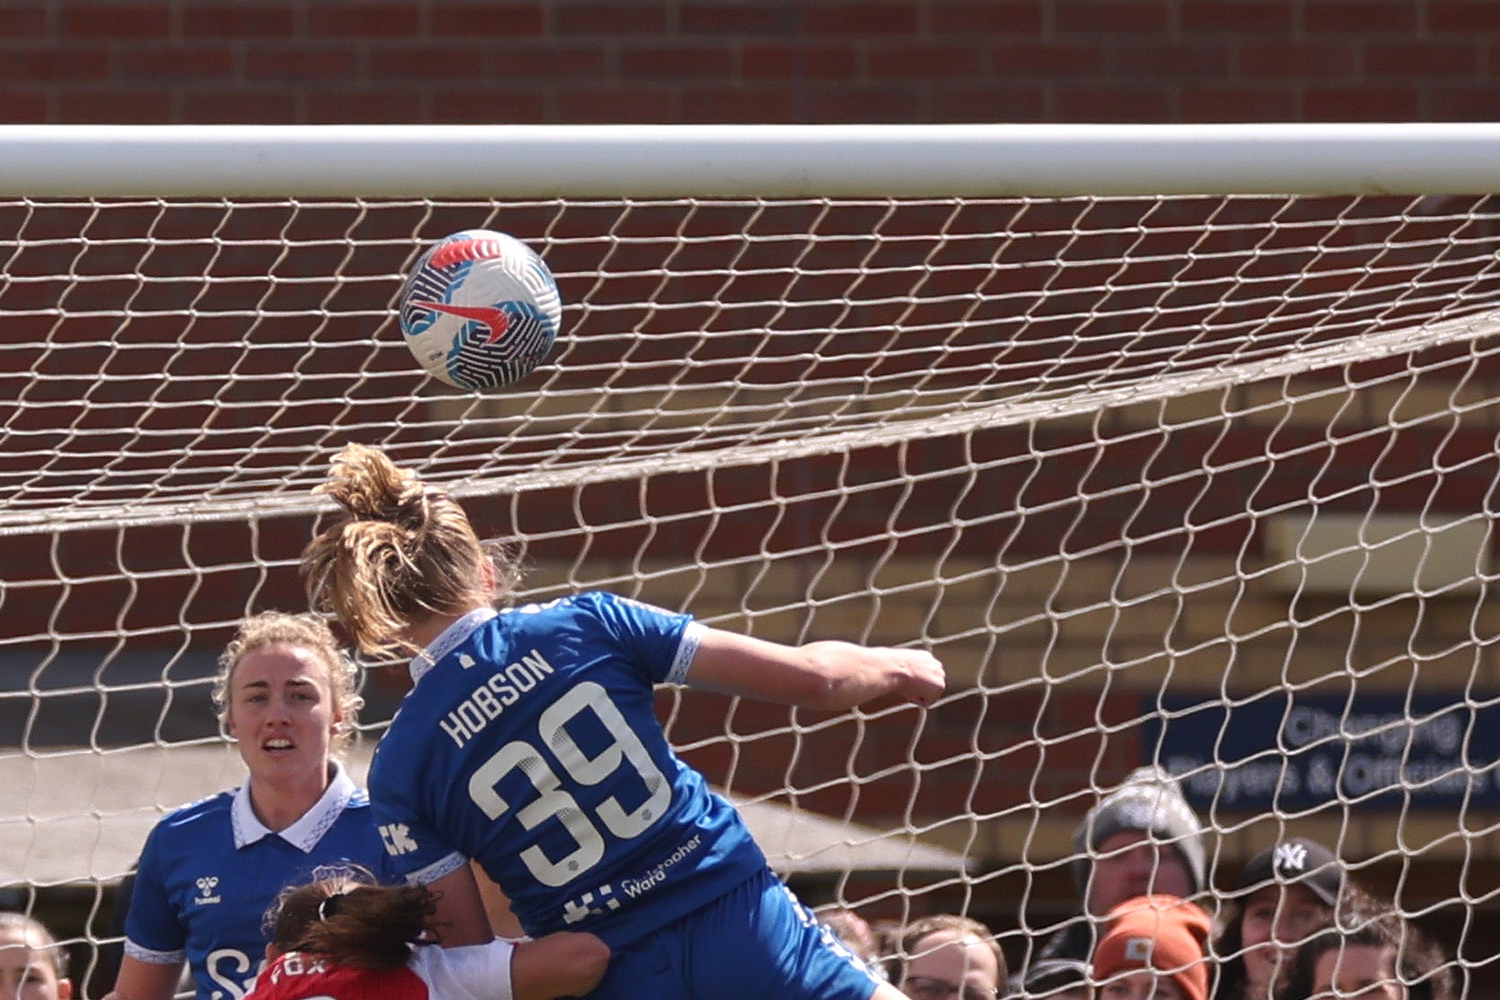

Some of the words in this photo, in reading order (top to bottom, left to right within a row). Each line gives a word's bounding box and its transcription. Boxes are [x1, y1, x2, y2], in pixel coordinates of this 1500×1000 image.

[440, 648, 555, 748] HOBSON
[468, 681, 672, 888] 39
[1309, 755, 1333, 793] &
[624, 870, 668, 899] Ward
[270, 956, 327, 985] FOX
